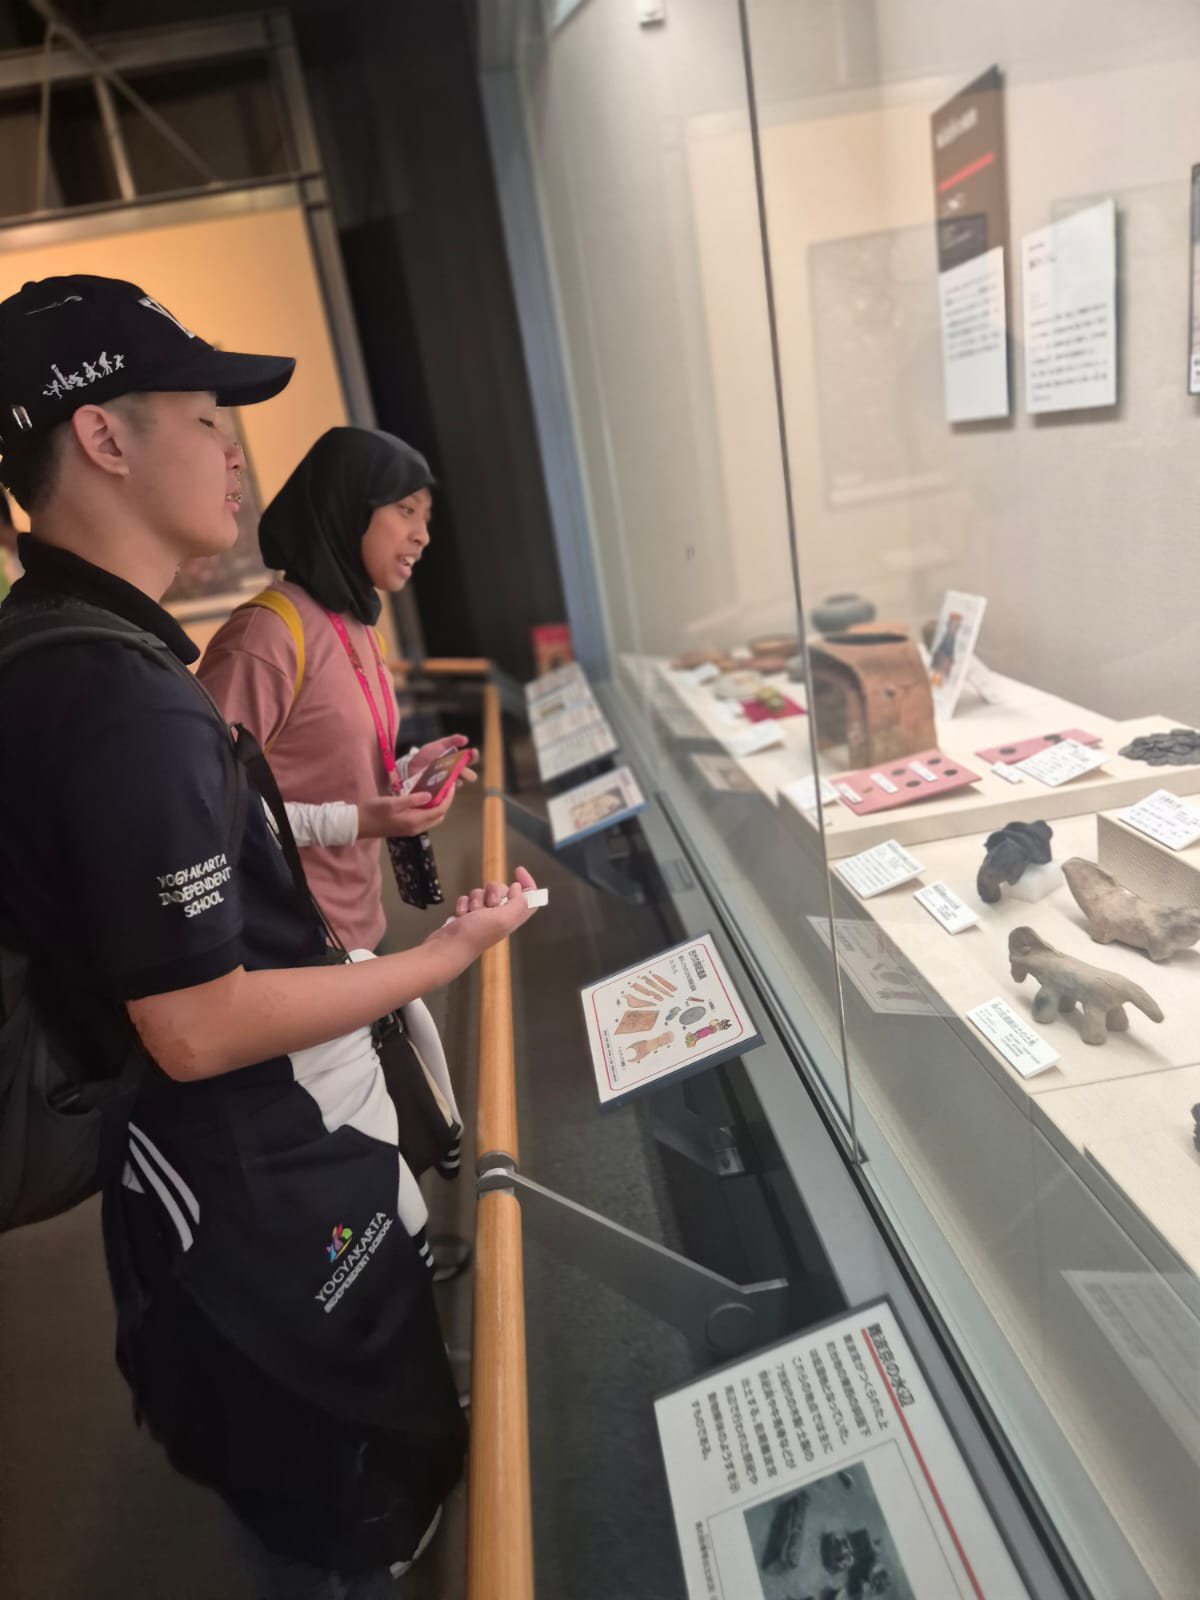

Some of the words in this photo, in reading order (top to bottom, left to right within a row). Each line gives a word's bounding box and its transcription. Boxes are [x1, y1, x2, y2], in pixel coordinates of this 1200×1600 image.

[156, 853, 227, 888] YOGYAKARTA
[158, 866, 232, 906] INDEPENDENT
[184, 890, 225, 918] SCHOOL
[314, 1211, 387, 1302] YOGYAKARTA
